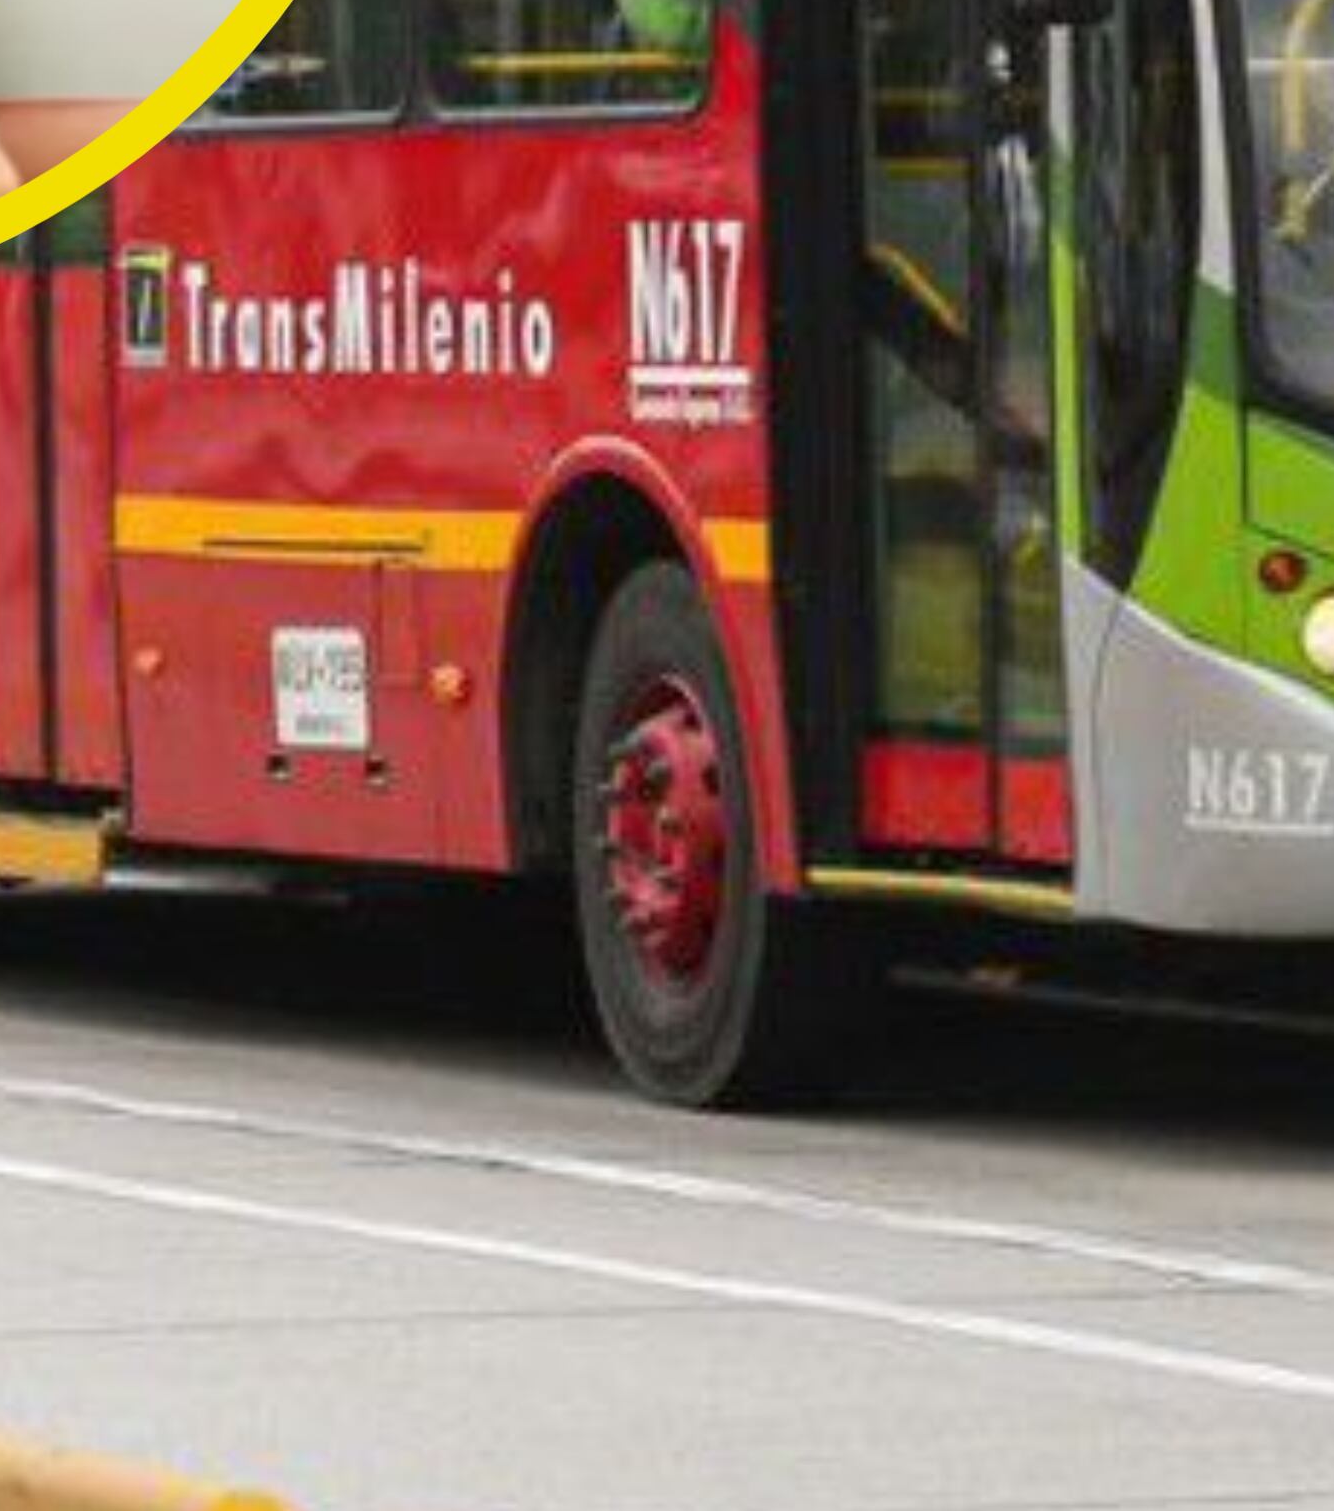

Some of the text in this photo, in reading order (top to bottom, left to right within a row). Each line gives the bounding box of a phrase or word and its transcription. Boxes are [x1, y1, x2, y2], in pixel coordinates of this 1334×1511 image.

[183, 257, 553, 376] TransMilenio
[627, 220, 744, 362] N617
[1188, 747, 1330, 823] N617
